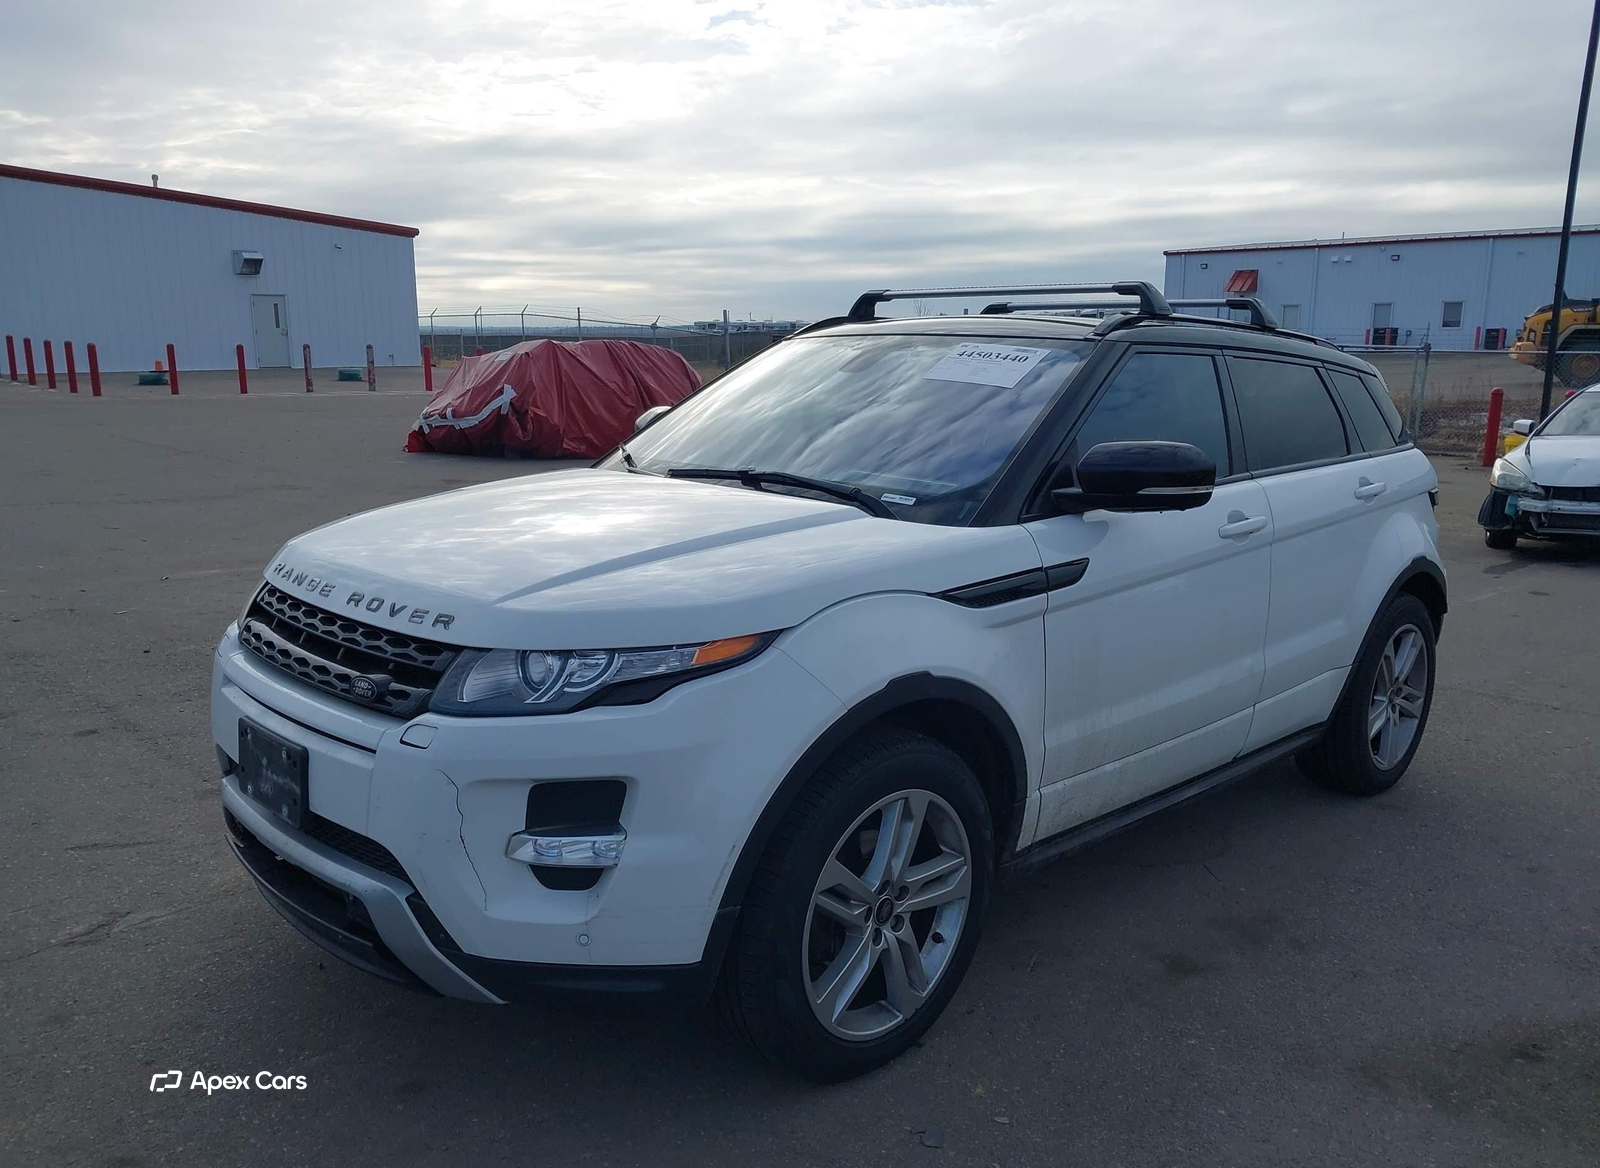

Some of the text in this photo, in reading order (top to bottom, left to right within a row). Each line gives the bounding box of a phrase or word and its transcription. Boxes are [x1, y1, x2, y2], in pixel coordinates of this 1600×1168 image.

[956, 350, 1029, 363] 44503440
[272, 562, 455, 631] RANGE ROVER
[354, 680, 369, 689] LAND
[355, 687, 372, 698] ROVER
